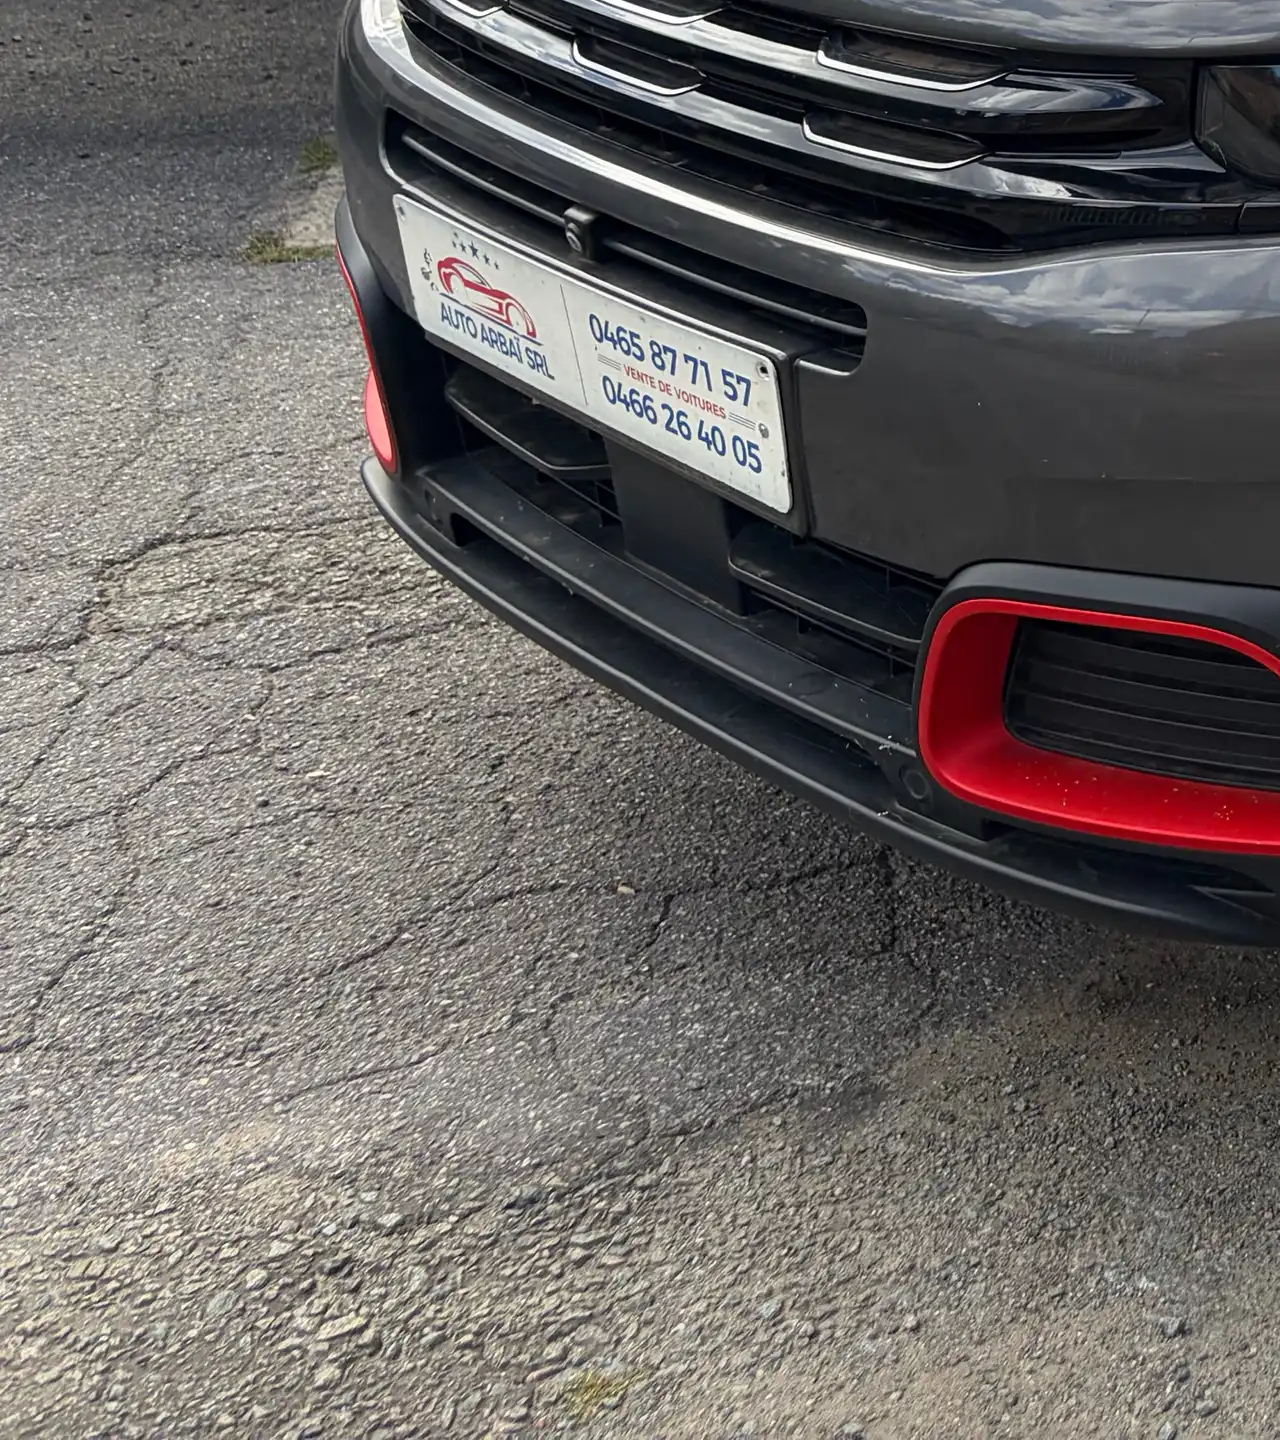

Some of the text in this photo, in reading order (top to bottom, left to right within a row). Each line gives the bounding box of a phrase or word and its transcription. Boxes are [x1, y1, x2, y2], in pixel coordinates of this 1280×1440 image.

[441, 302, 555, 380] AUTO ARBAÏ SRL
[589, 313, 752, 407] 0465 87 71 57
[602, 375, 762, 474] 0466 26 40 05
[623, 364, 727, 419] VENTE DE VOITURES
